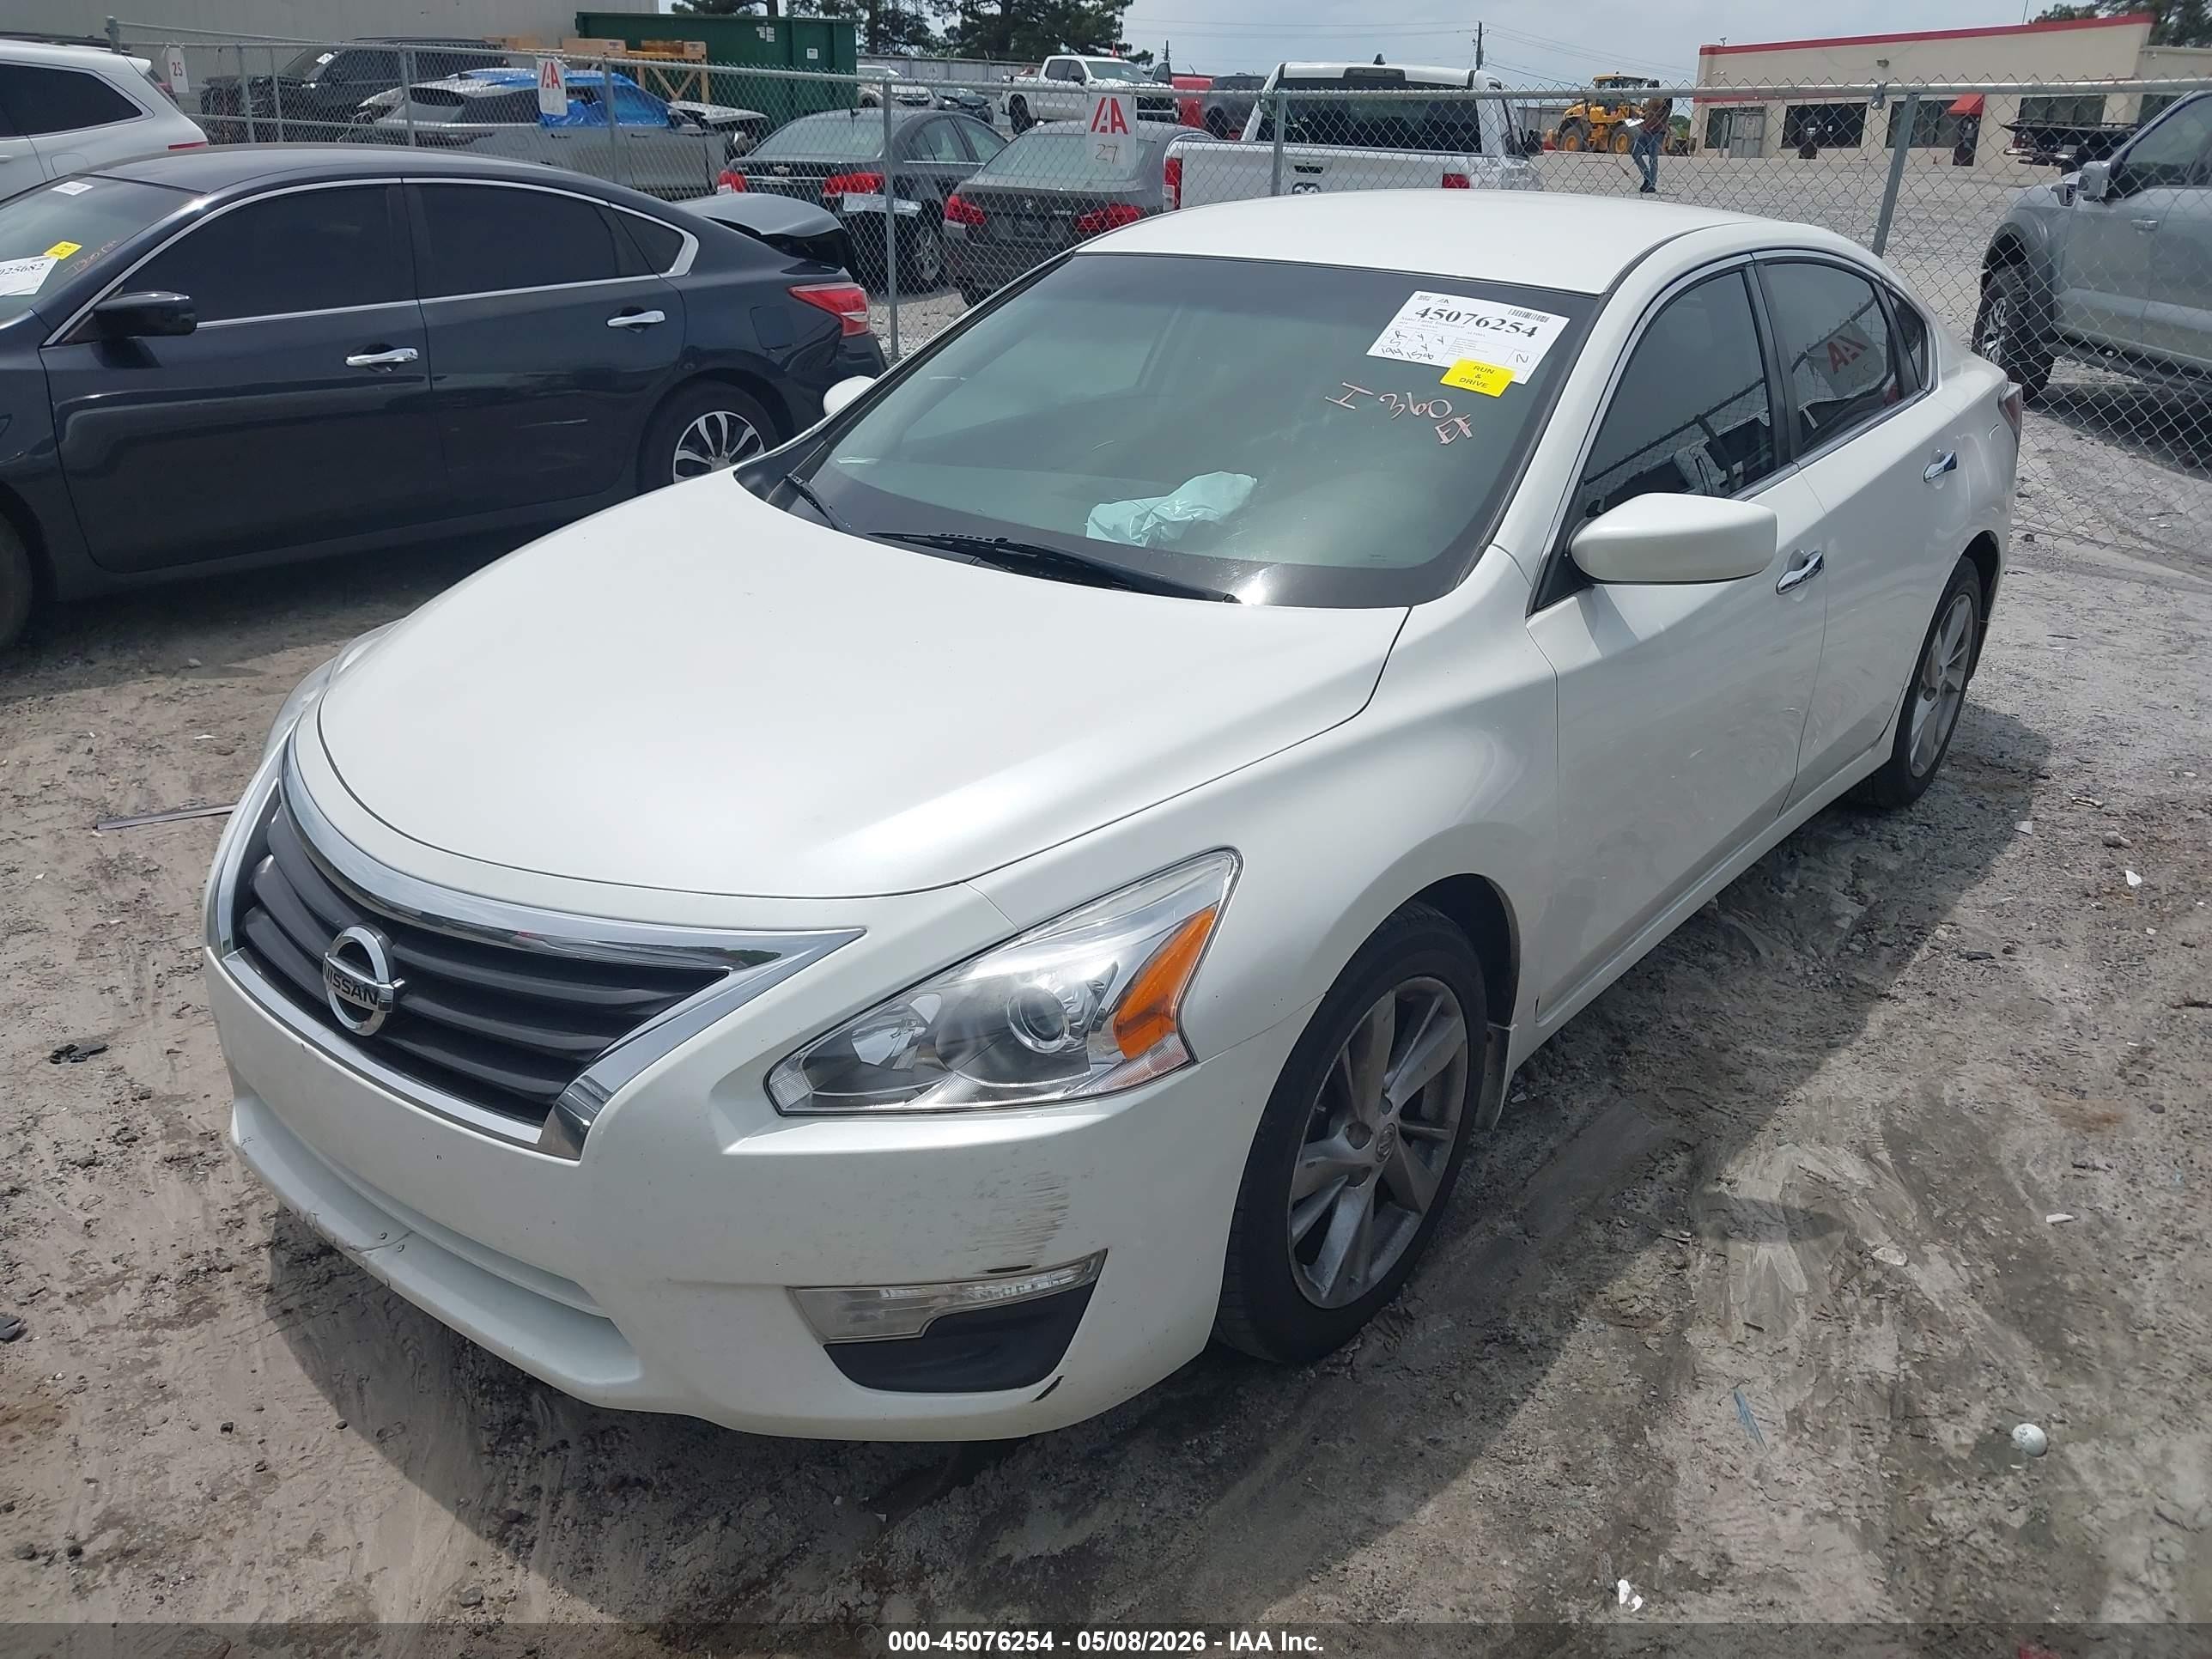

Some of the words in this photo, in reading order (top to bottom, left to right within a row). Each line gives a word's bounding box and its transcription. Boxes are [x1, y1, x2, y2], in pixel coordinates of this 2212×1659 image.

[1095, 143, 1118, 164] 27
[1415, 307, 1539, 337] 45076254
[1516, 353, 1529, 364] N
[1473, 365, 1495, 374] RUN
[1459, 377, 1489, 389] DRIVE
[1379, 391, 1453, 419] 360
[325, 967, 378, 1006] NISSAN
